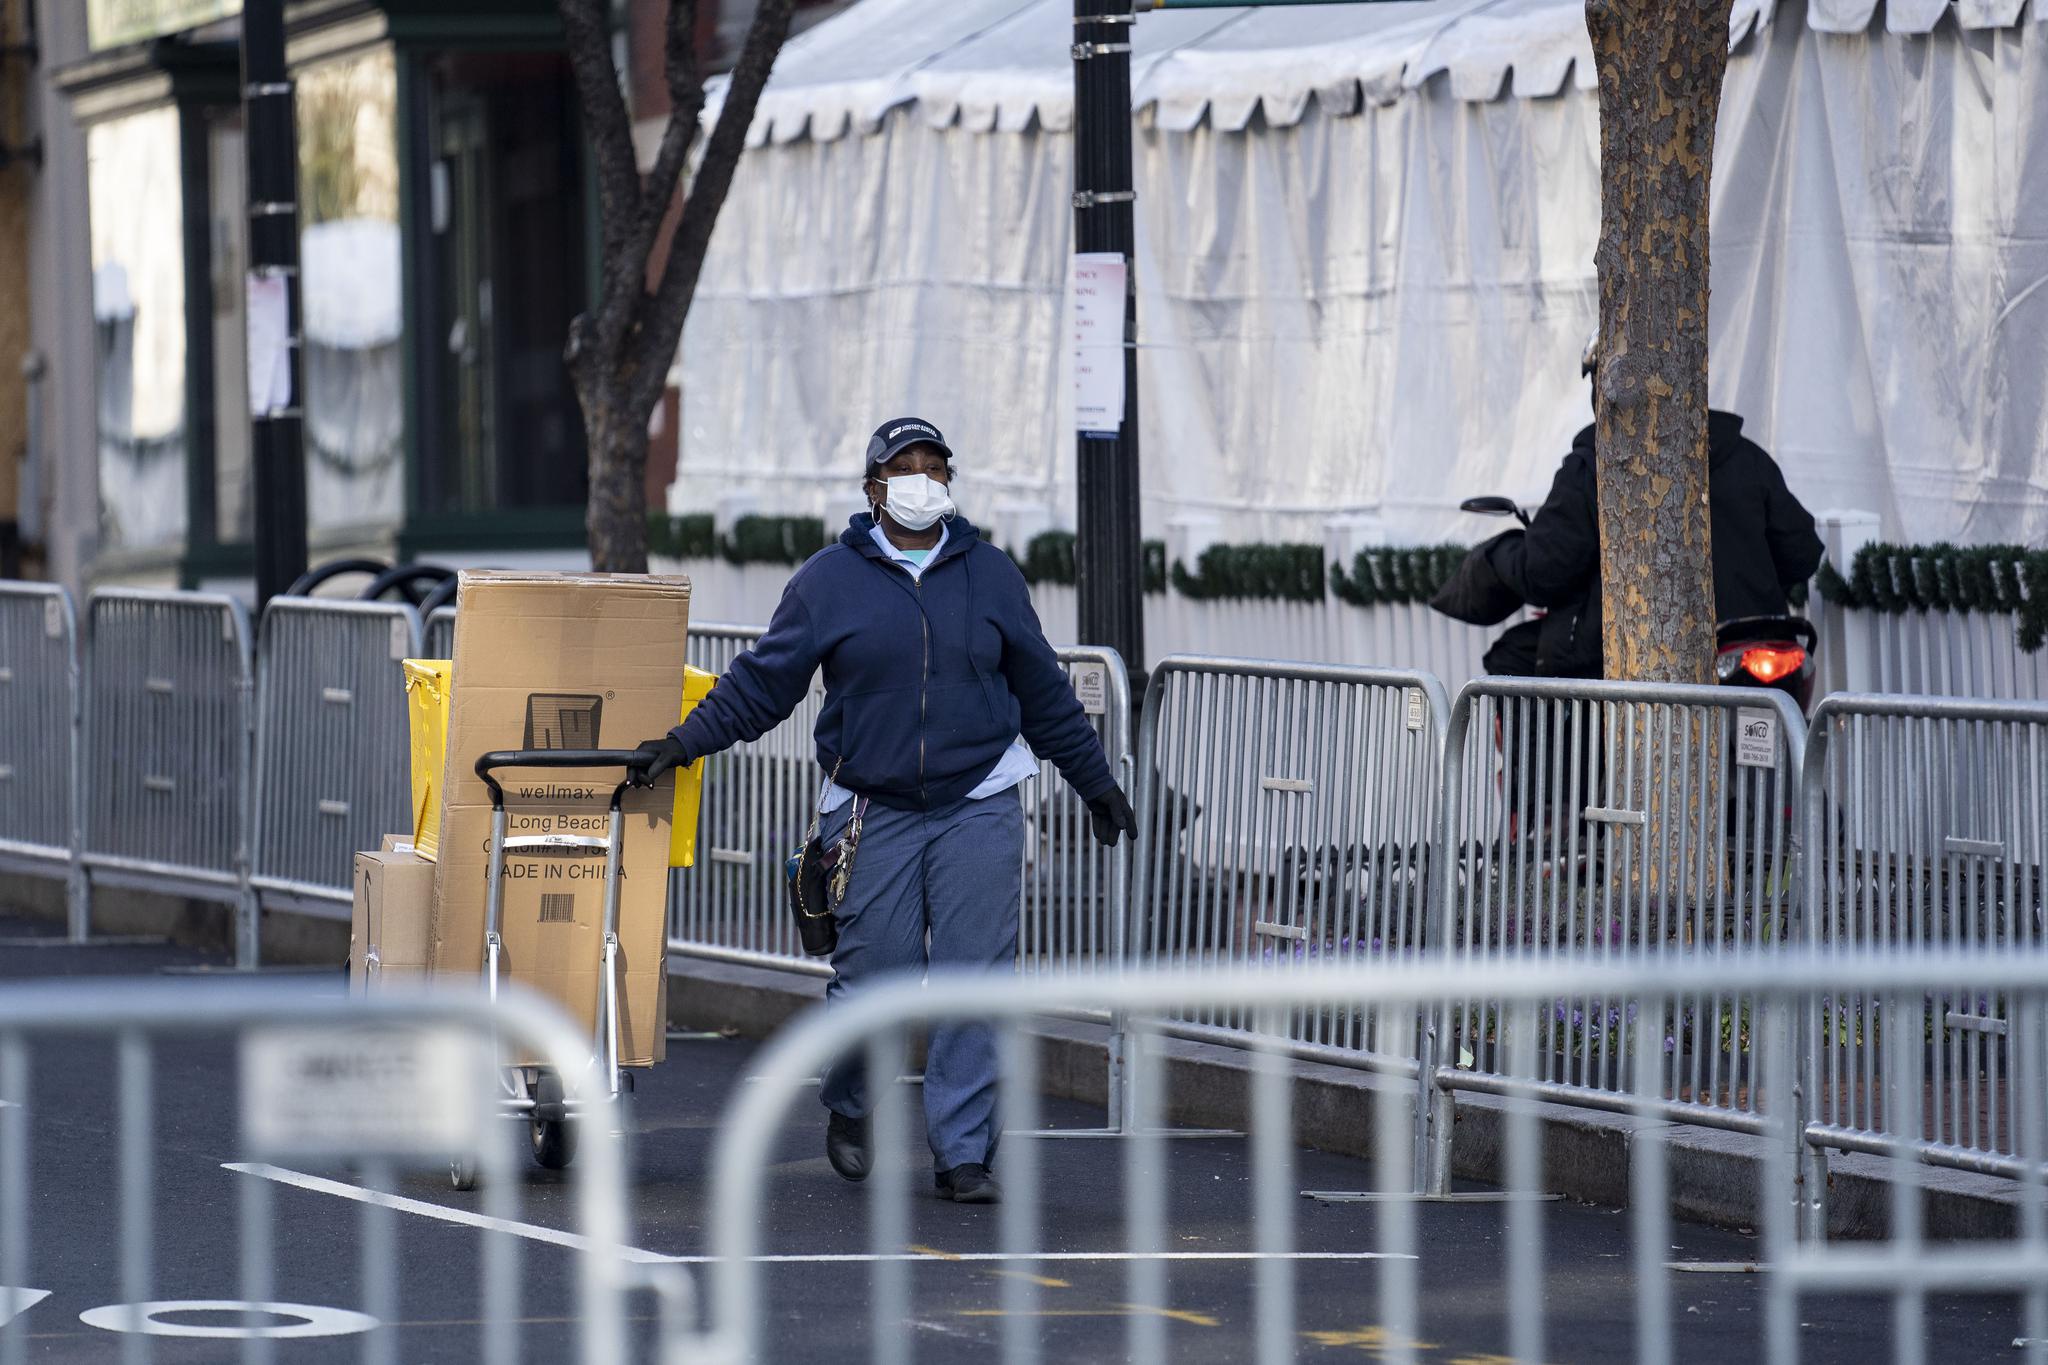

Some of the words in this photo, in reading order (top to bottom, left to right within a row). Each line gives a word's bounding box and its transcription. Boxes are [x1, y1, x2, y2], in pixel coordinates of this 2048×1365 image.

[1744, 723, 1768, 738] SONCO
[520, 784, 595, 800] wellmax
[509, 814, 552, 832] Long
[544, 865, 562, 879] IN
